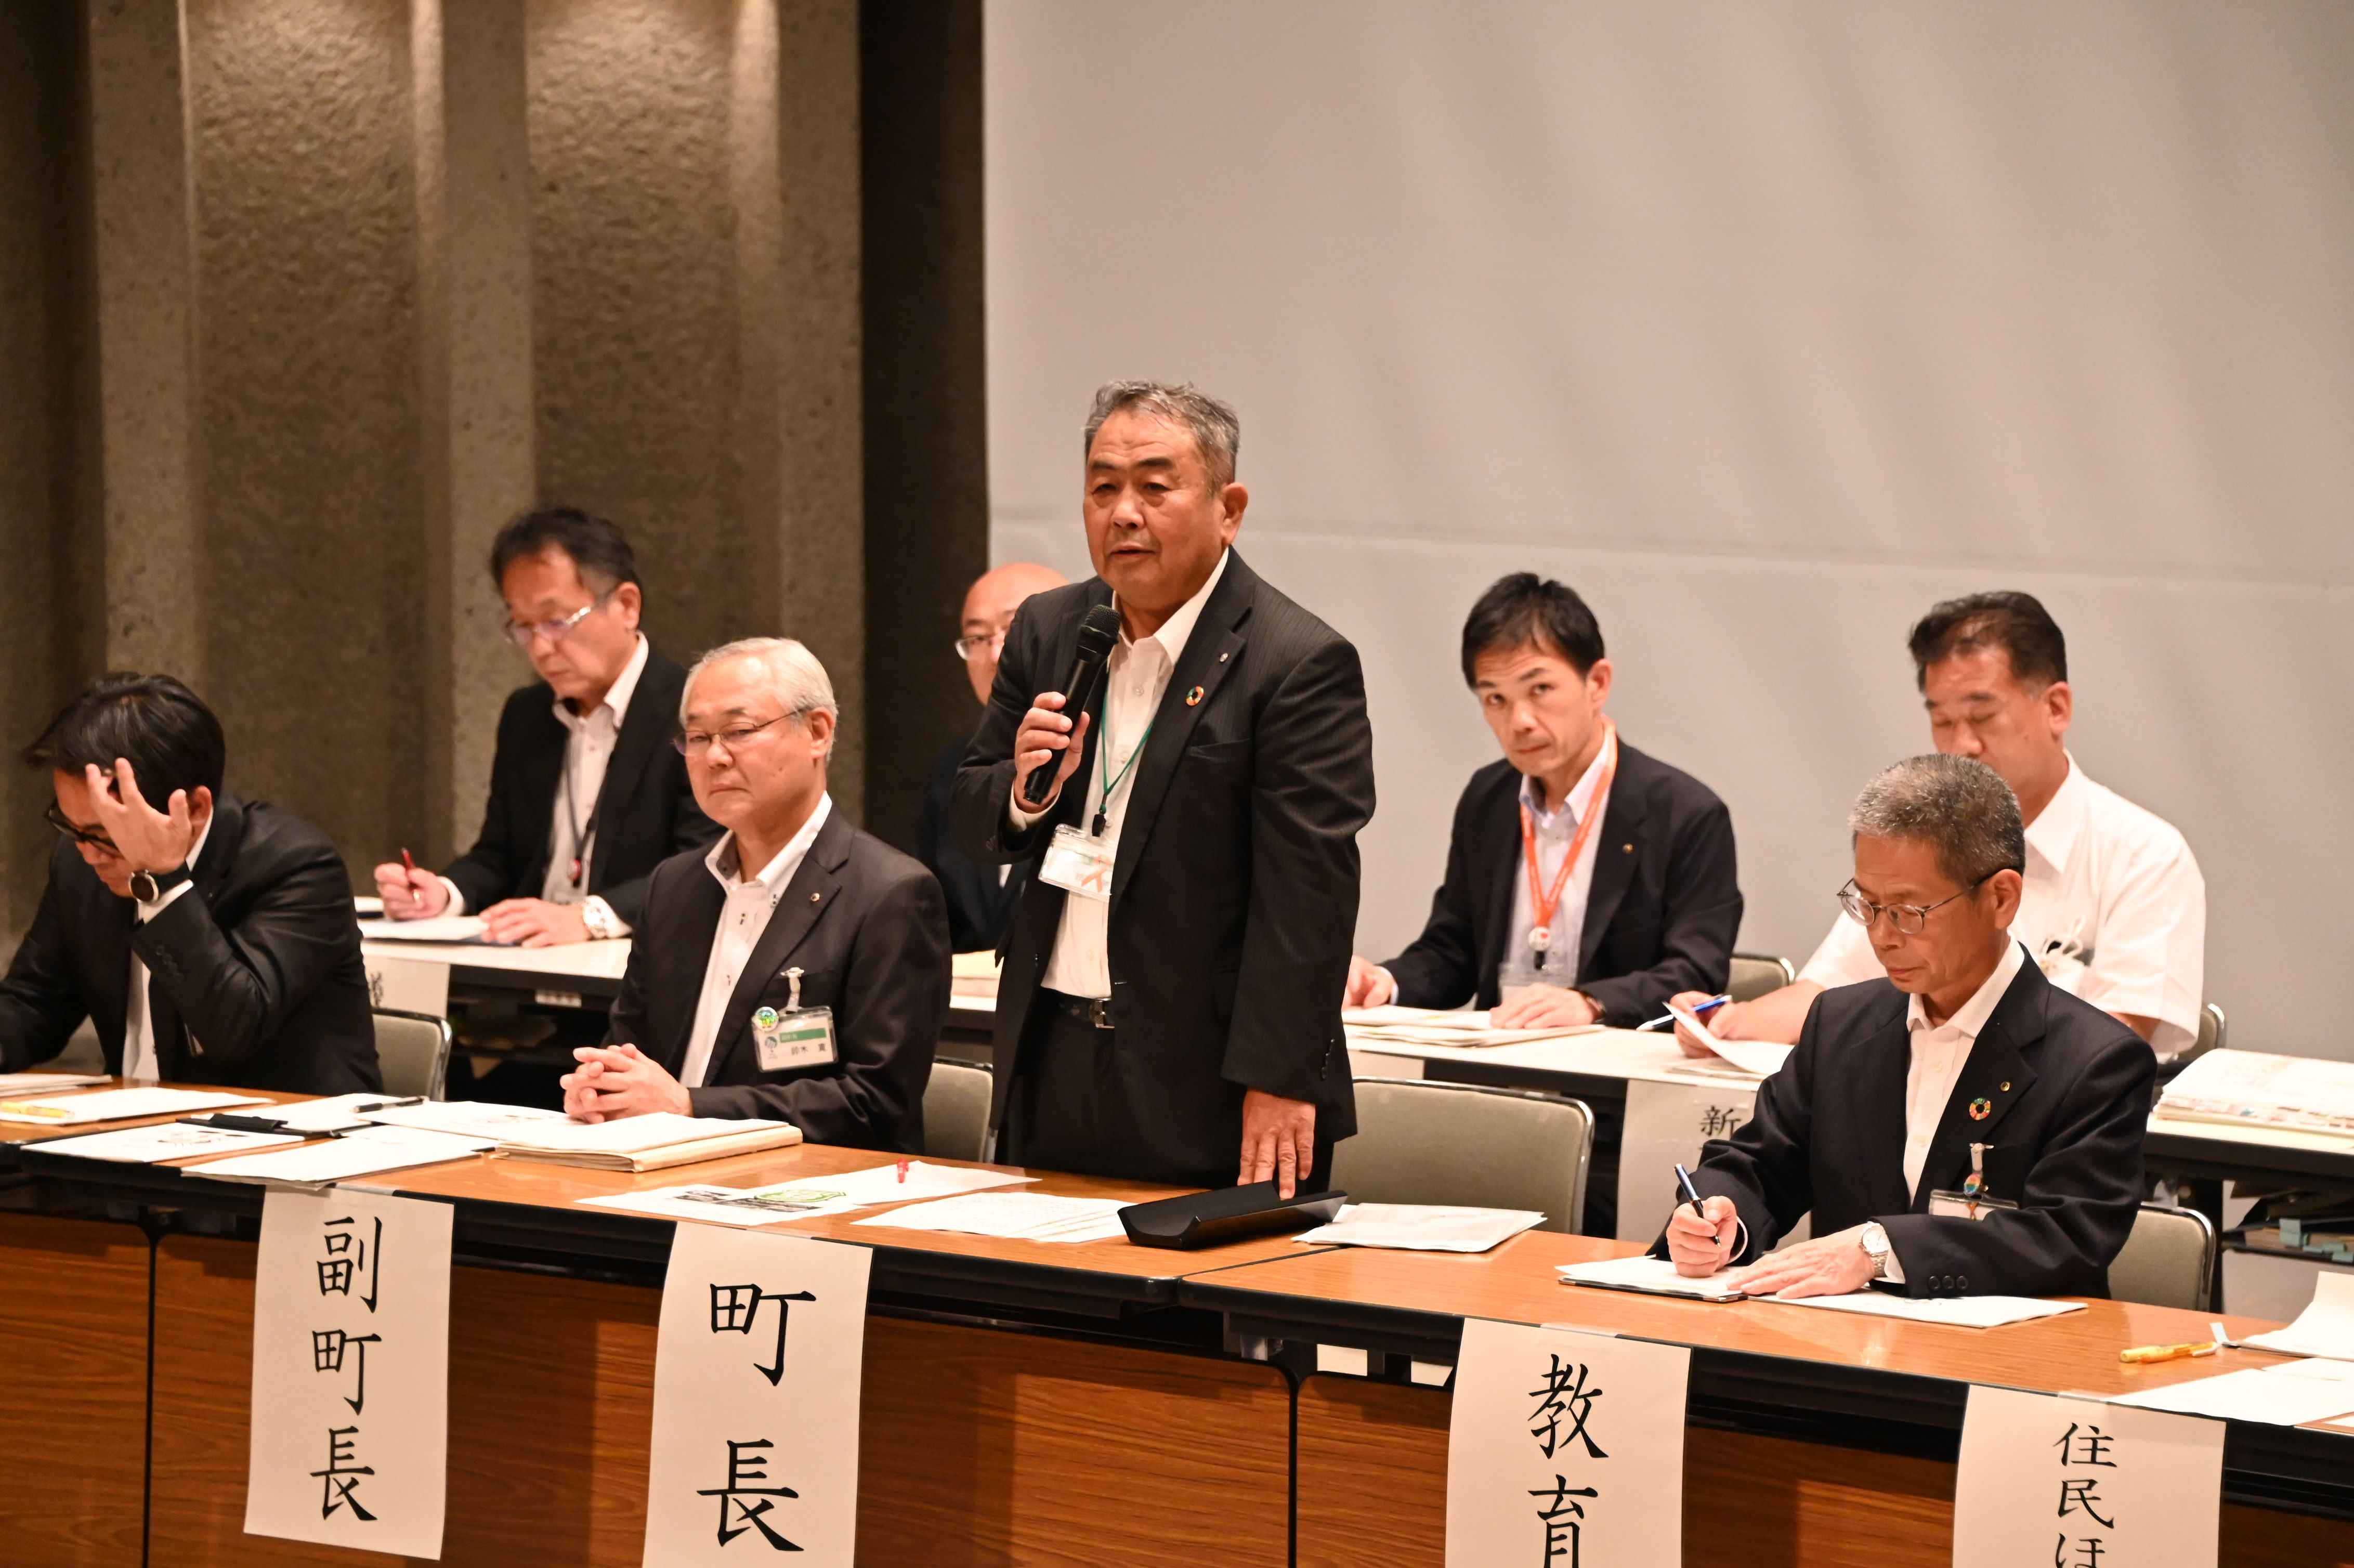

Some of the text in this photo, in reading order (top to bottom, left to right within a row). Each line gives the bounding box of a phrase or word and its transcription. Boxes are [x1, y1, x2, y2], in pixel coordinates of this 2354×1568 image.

[1698, 1105, 1742, 1149] 新
[310, 1216, 383, 1522] 副町長
[697, 1283, 817, 1552] 町長
[1527, 1353, 1610, 1568] 教育
[2052, 1422, 2117, 1568] 住民ほ
